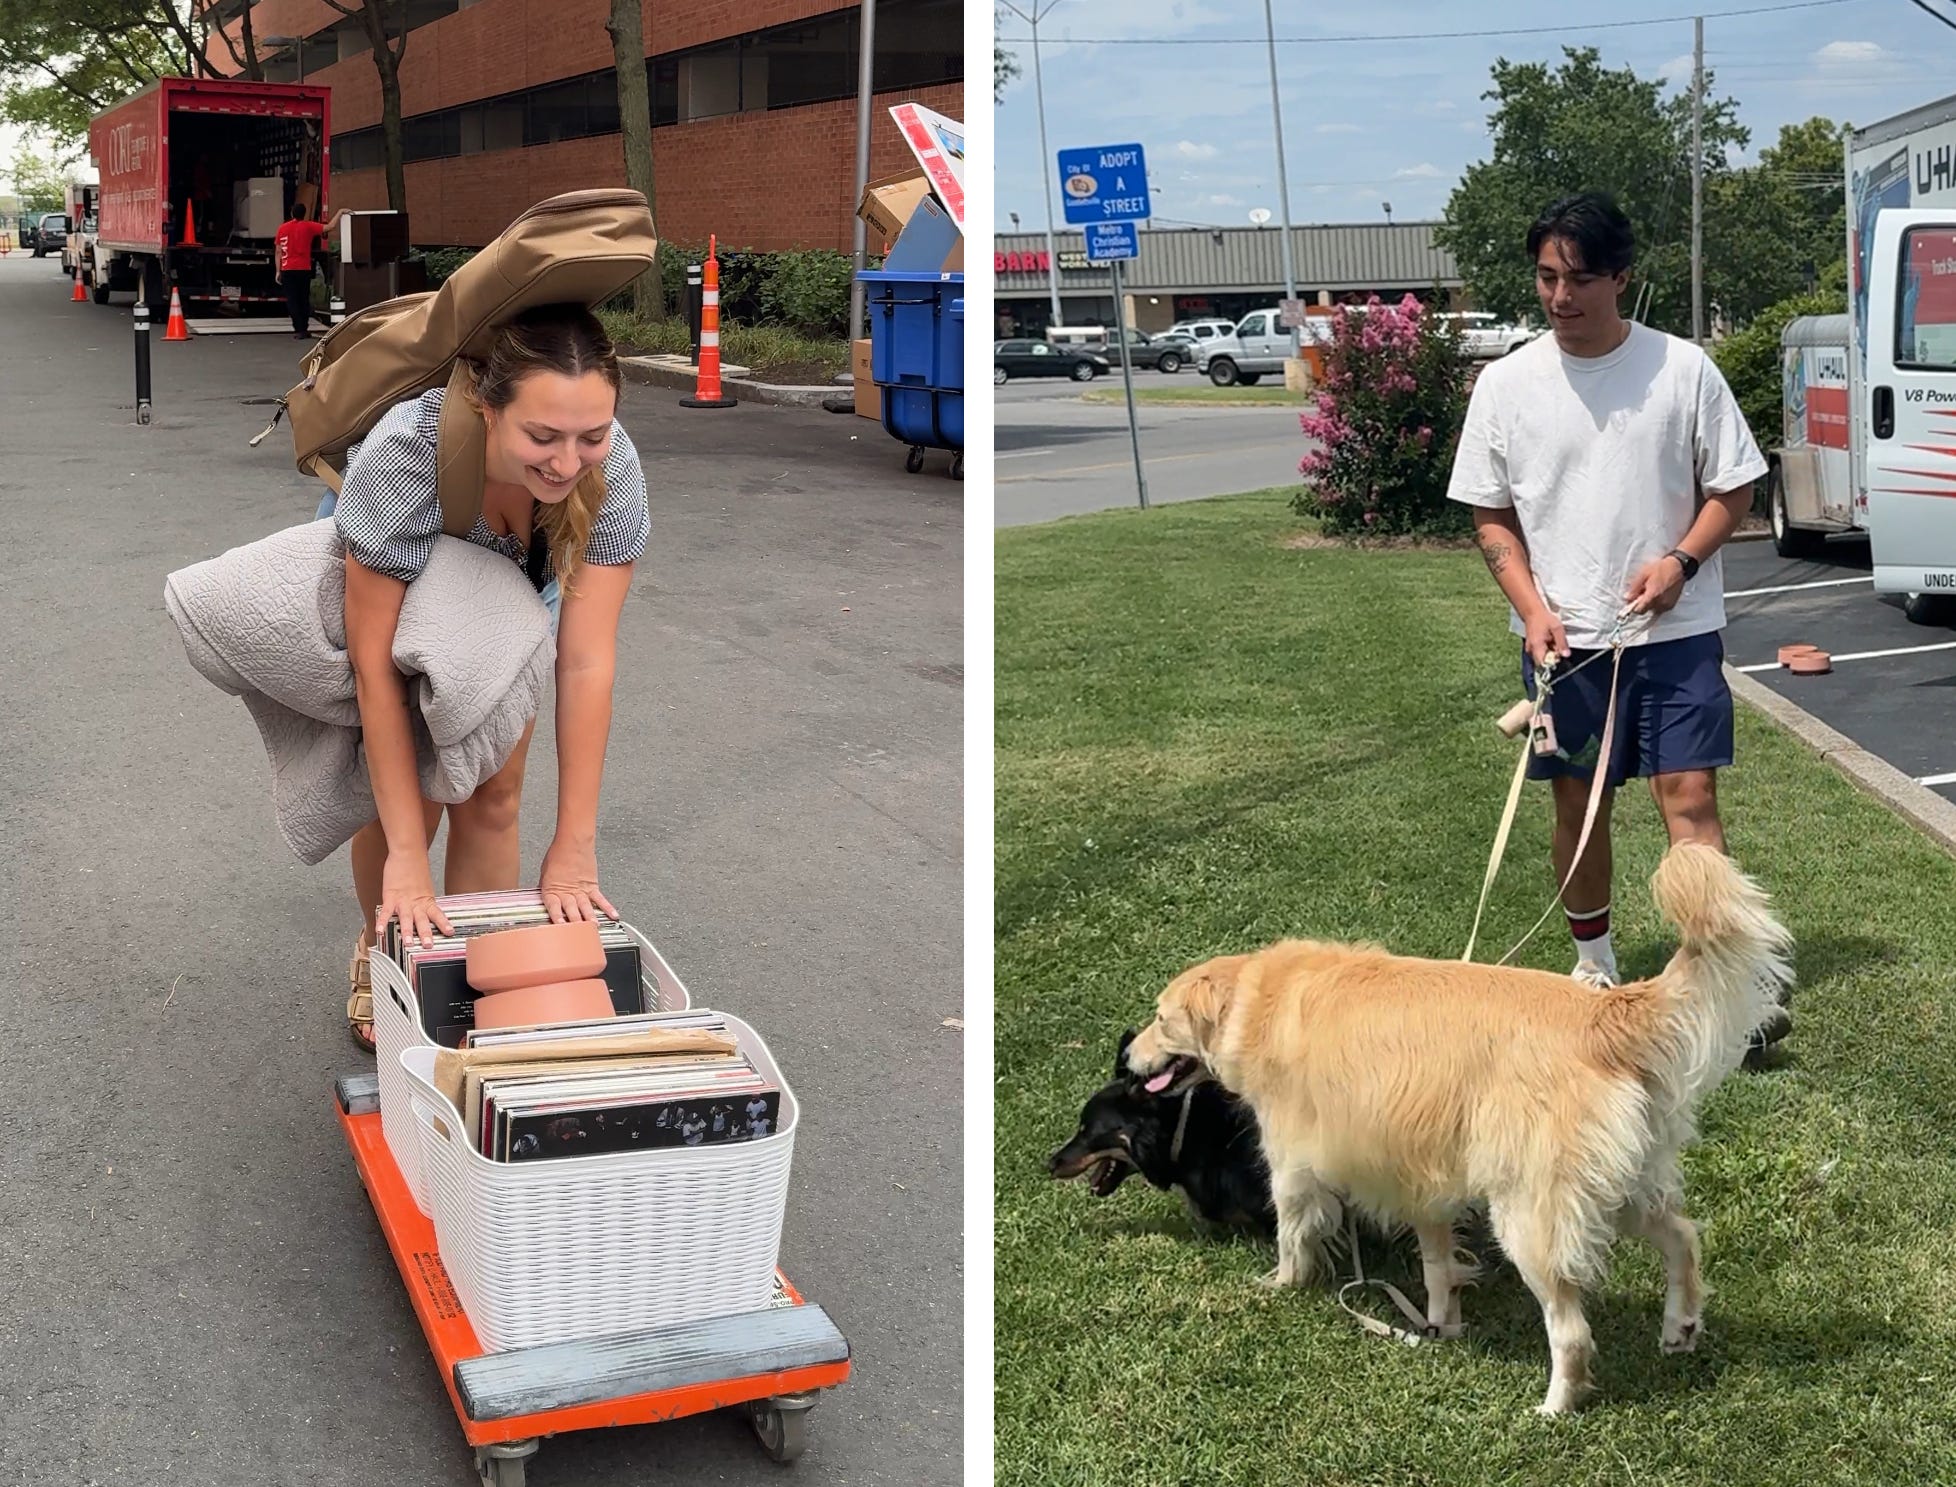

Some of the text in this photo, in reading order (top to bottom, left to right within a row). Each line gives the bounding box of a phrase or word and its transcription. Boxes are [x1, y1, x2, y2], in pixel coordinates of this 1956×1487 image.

[1100, 152, 1138, 168] ADOPT
[1116, 176, 1126, 191] A
[1103, 197, 1145, 214] STREET
[1097, 225, 1123, 235] Metro
[1092, 237, 1132, 248] Christian
[1093, 248, 1133, 258] Academy
[994, 251, 1049, 272] BARN
[1905, 389, 1924, 402] V8
